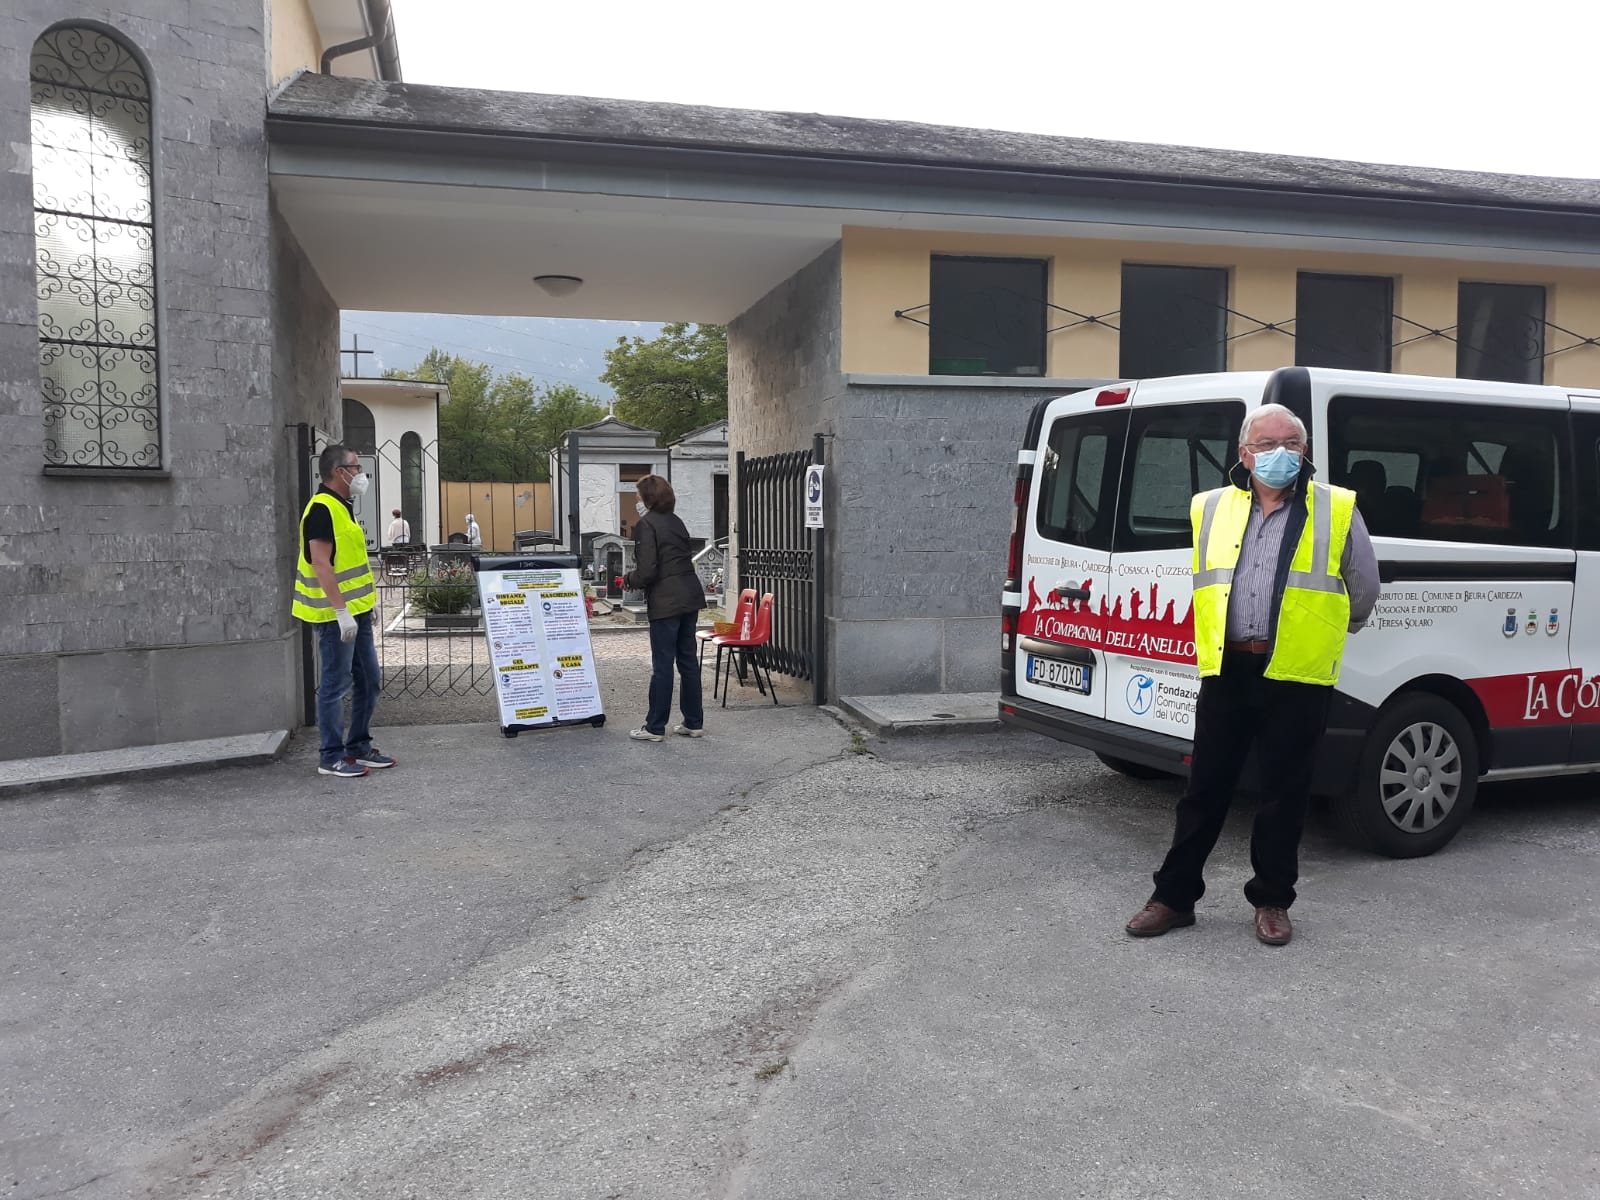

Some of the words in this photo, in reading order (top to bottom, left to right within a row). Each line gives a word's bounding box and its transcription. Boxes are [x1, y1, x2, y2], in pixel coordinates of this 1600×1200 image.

[1060, 557, 1078, 569] BEURA
[1081, 559, 1113, 574] CARDEZZA
[1118, 563, 1150, 577] COSASCA
[1405, 592, 1419, 601] DEL
[1422, 590, 1454, 603] COMUNE
[1455, 592, 1462, 600] DI
[1464, 590, 1487, 602] BEURA
[1487, 590, 1523, 602] CARDEZZA
[1426, 605, 1458, 614] RICORDO
[1034, 614, 1044, 636] LA
[1044, 616, 1102, 643] COMPAGNIA
[1377, 617, 1403, 630] TERESA
[1404, 617, 1434, 630] SOLARO
[1158, 682, 1199, 700] Fondazio
[1523, 674, 1549, 721] LA
[1156, 695, 1197, 713] Comunita
[1156, 708, 1168, 720] del
[1169, 710, 1189, 725] VCO
